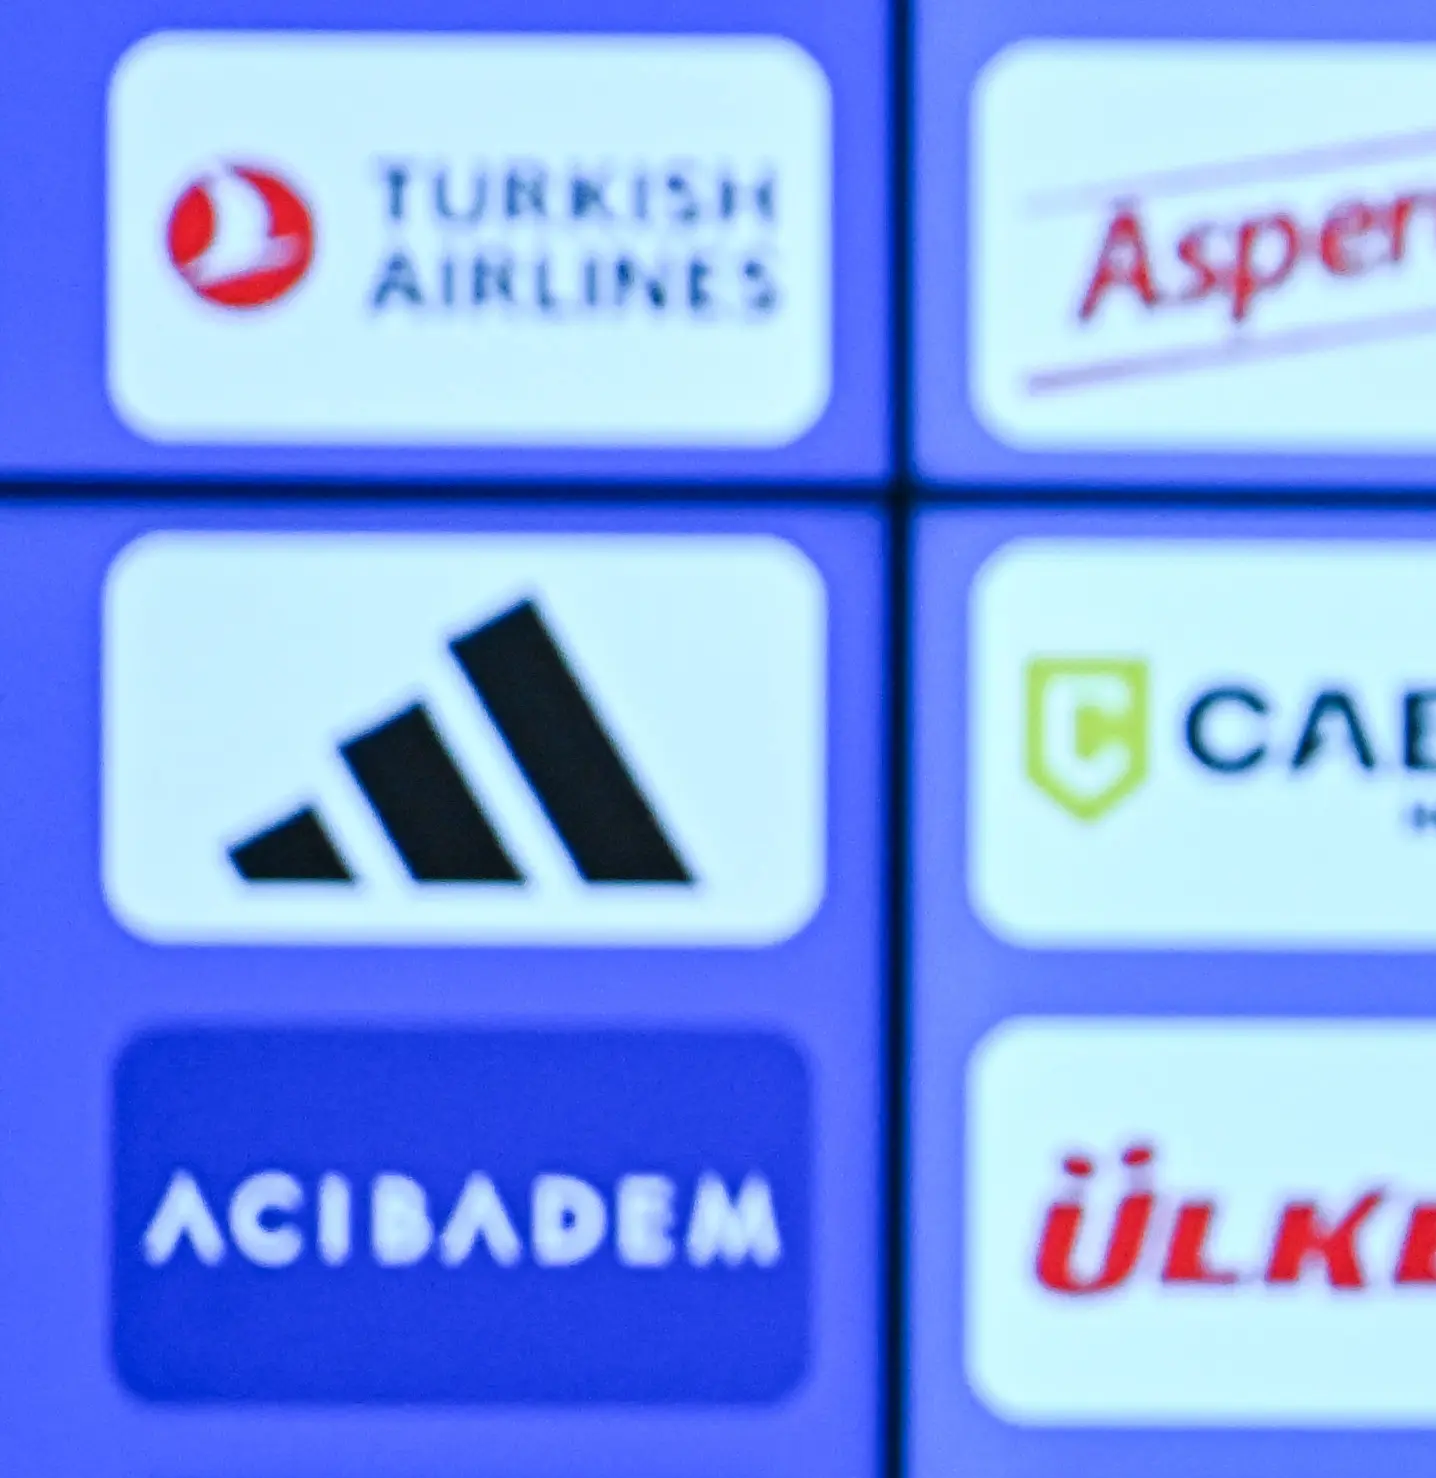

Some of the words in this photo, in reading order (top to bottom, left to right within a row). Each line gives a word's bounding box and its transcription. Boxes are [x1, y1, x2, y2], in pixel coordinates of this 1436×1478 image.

[372, 157, 781, 230] TURKISH
[367, 248, 784, 318] AIRLINES
[142, 1168, 782, 1270] ACIBADEM
